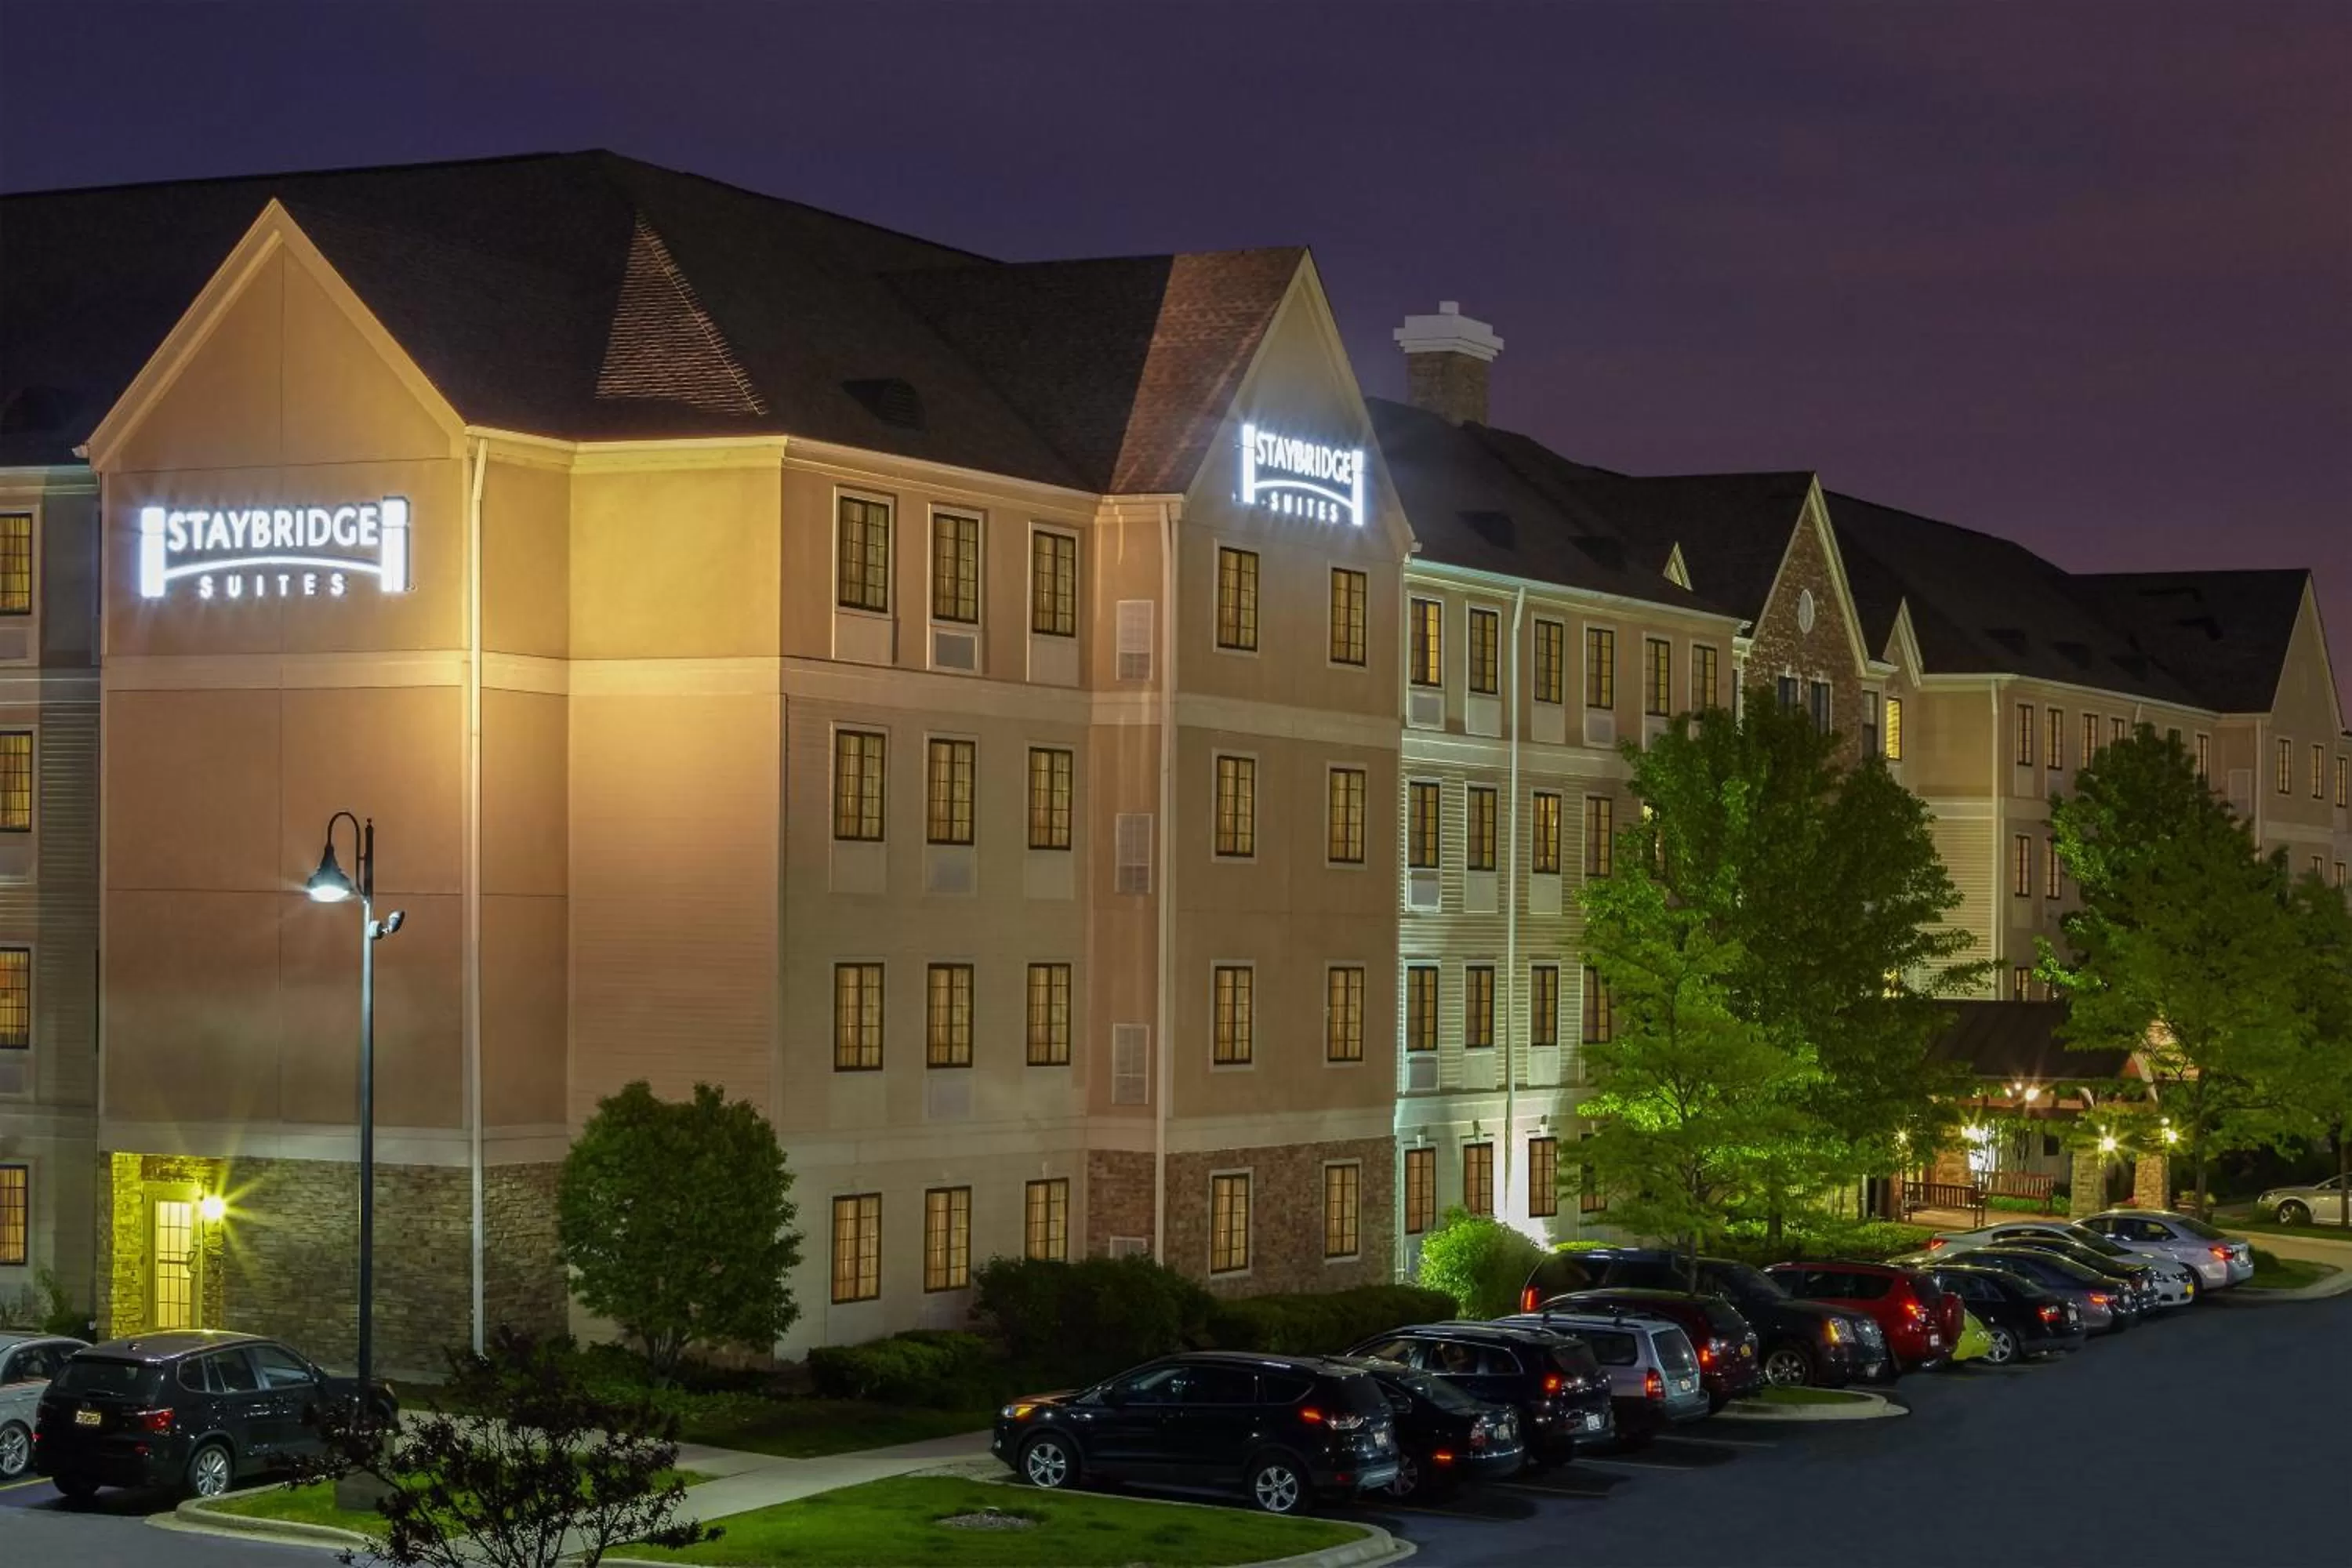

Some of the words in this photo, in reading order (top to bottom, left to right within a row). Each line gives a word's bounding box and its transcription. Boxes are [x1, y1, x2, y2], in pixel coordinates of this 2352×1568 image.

[1256, 432, 1352, 484] STAYBRIDGE
[1271, 492, 1338, 523] SUITES
[167, 507, 379, 551] STAYBRIDGE
[199, 573, 346, 599] SUITES
